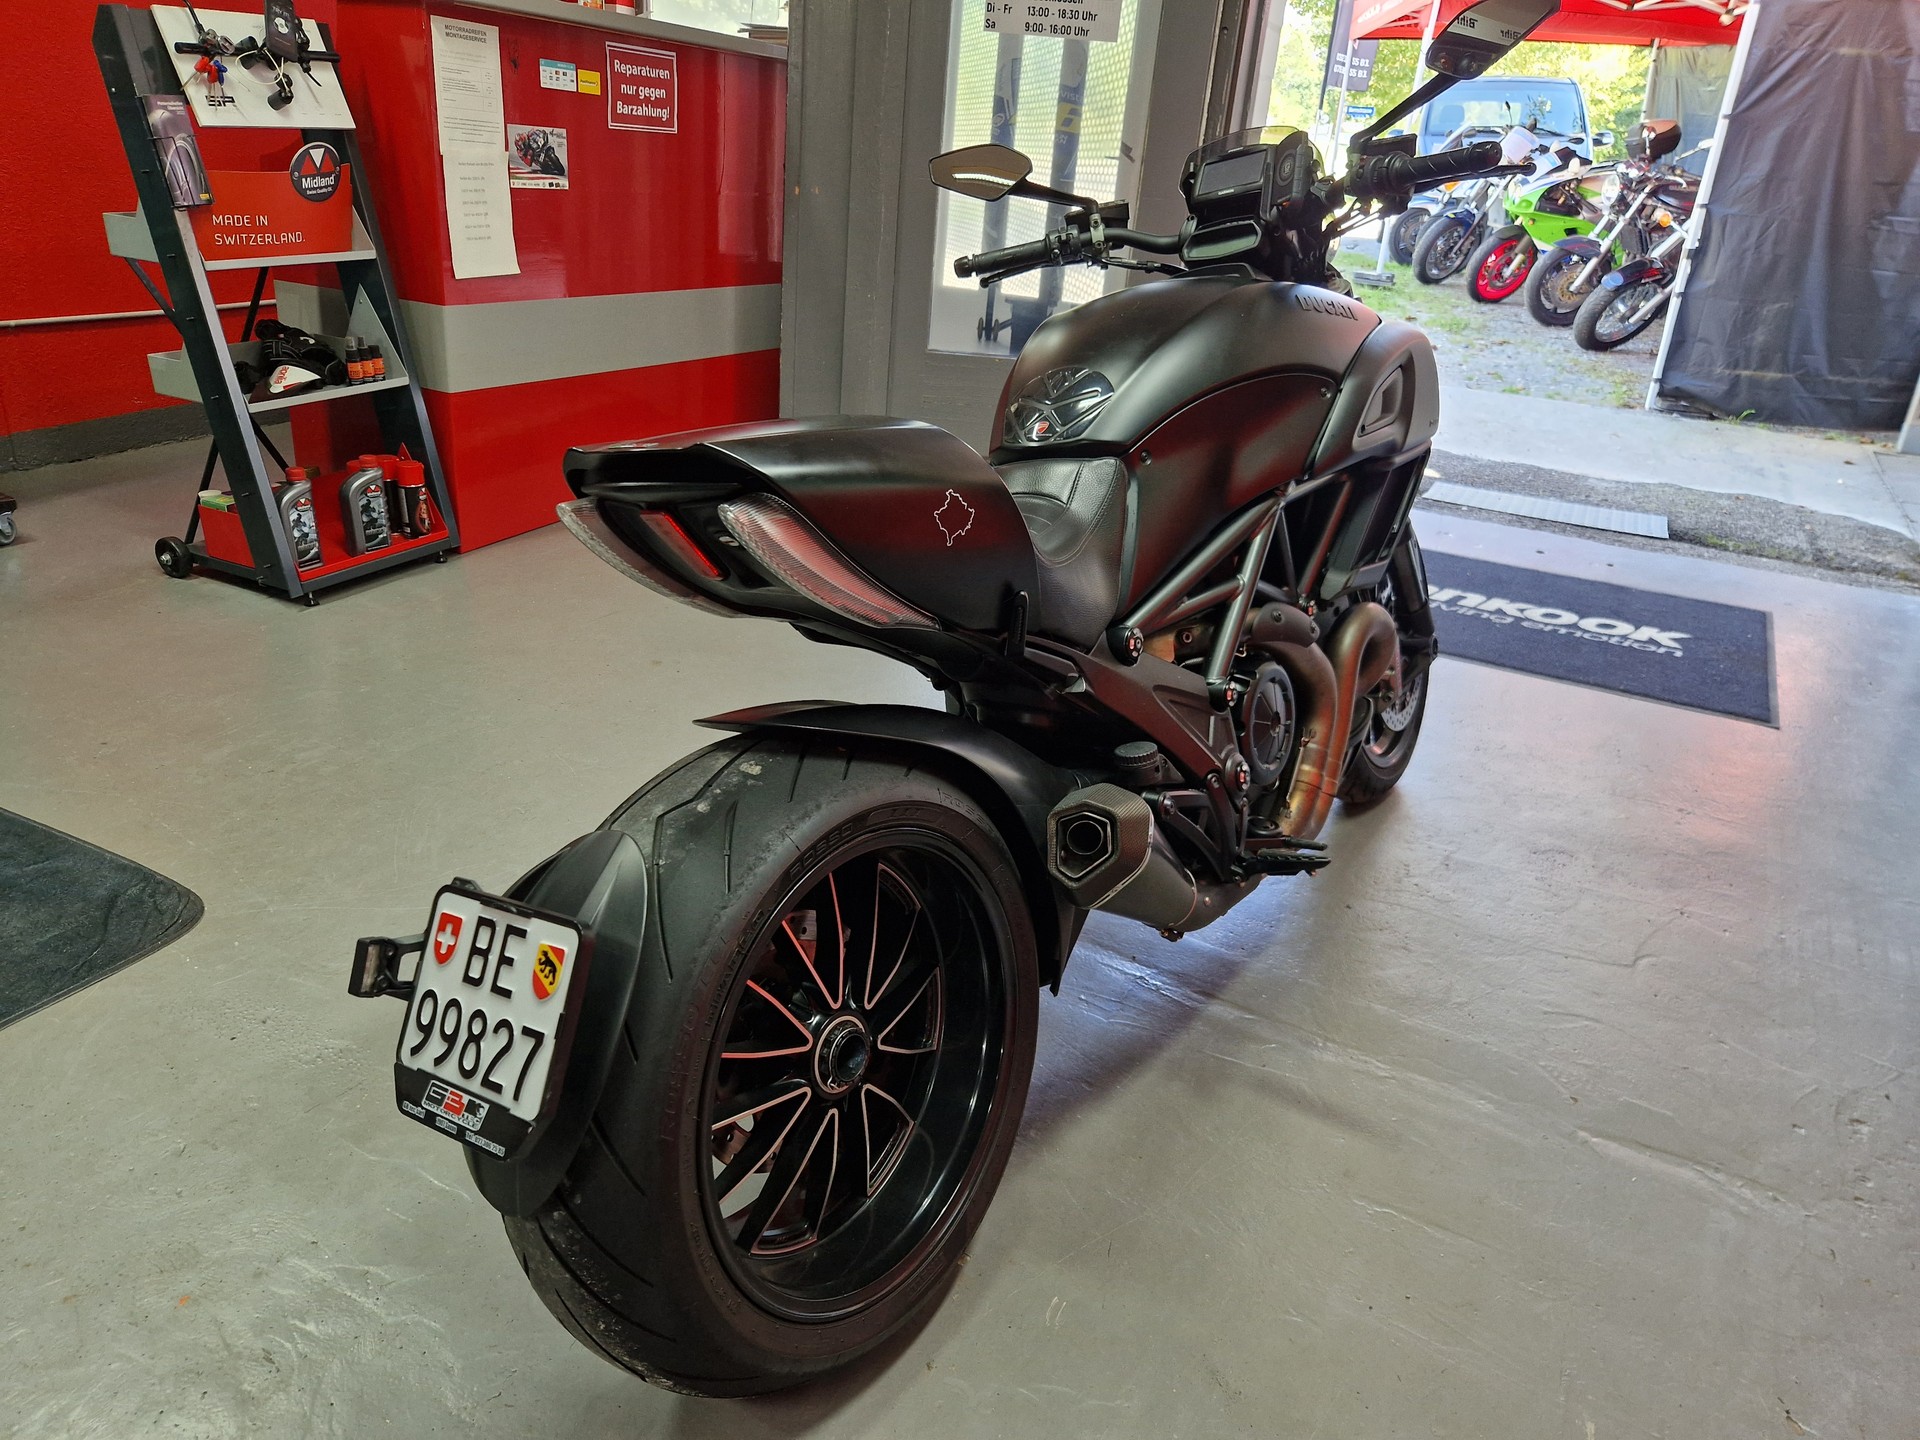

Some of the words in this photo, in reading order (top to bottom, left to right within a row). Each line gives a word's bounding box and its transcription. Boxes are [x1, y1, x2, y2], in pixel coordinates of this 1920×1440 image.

[986, 3, 996, 13] Di
[1003, 4, 1013, 14] Fr
[1027, 6, 1050, 17] 13:00
[1057, 9, 1080, 20] 18:30
[1082, 10, 1098, 22] Uhr
[985, 18, 996, 29] Sa
[1050, 24, 1072, 36] 16:00
[1074, 26, 1090, 37] Uhr
[445, 32, 487, 44] MONTAGESERVICE
[614, 59, 670, 80] Reparaturen
[620, 83, 636, 96] nur
[638, 86, 666, 101] gegen
[616, 101, 670, 122] Barzahlung!
[301, 174, 336, 190] Midland
[212, 214, 252, 227] MADE
[255, 214, 269, 227] IN
[214, 231, 306, 246] SWITZERLAND.
[1295, 294, 1359, 321] DUCATI
[462, 914, 528, 1000] BE
[409, 988, 546, 1103] 99827
[423, 1101, 477, 1129] MOTORCYCLE
